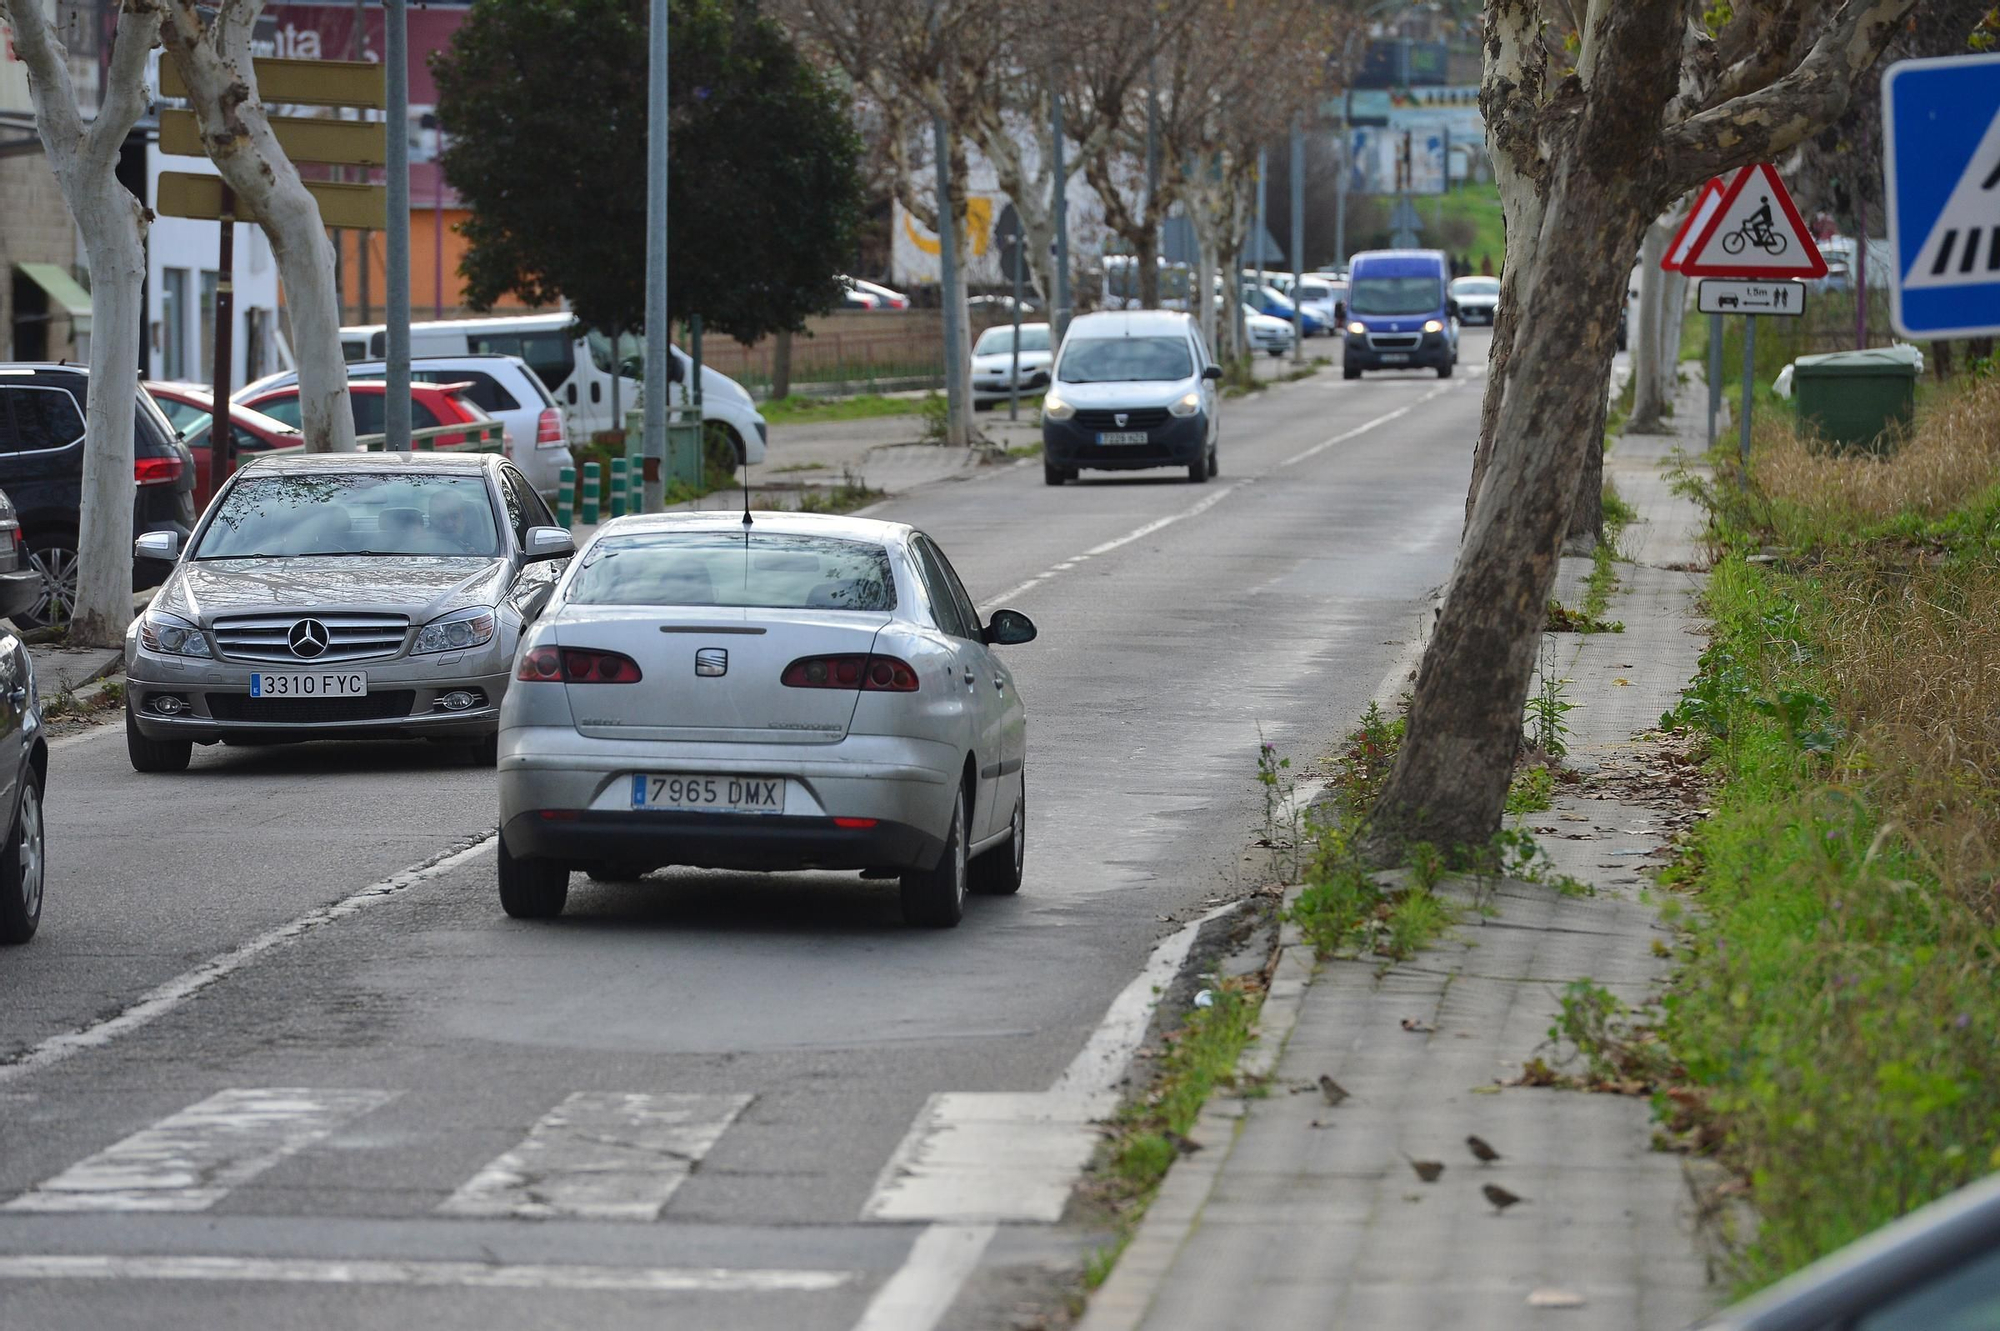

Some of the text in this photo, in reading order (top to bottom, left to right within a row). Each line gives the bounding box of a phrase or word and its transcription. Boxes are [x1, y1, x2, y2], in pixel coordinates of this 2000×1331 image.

[264, 676, 315, 694] 3310
[323, 675, 361, 694] FYC
[652, 778, 717, 803] 7965
[728, 781, 777, 806] DMX
